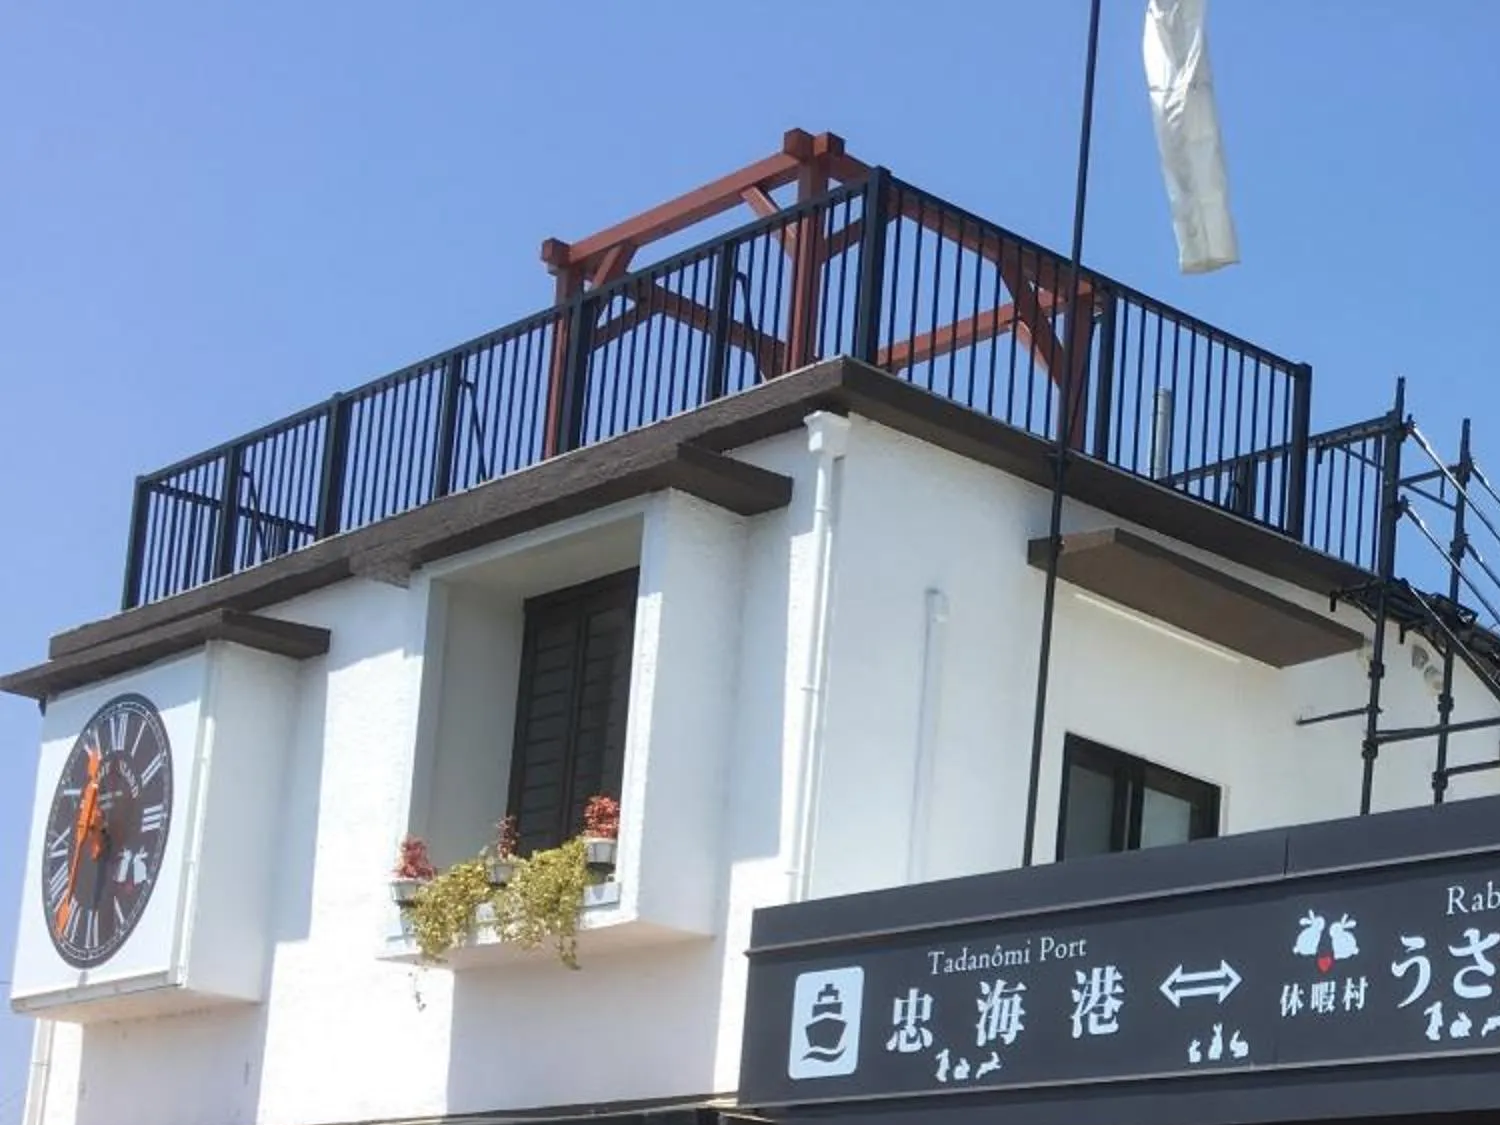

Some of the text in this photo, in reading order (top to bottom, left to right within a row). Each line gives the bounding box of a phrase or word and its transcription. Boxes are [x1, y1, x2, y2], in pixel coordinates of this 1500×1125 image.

[928, 936, 1087, 975] Tadanômi Port
[885, 965, 1126, 1054] 忠海港
[1279, 975, 1369, 1017] 休暇村
